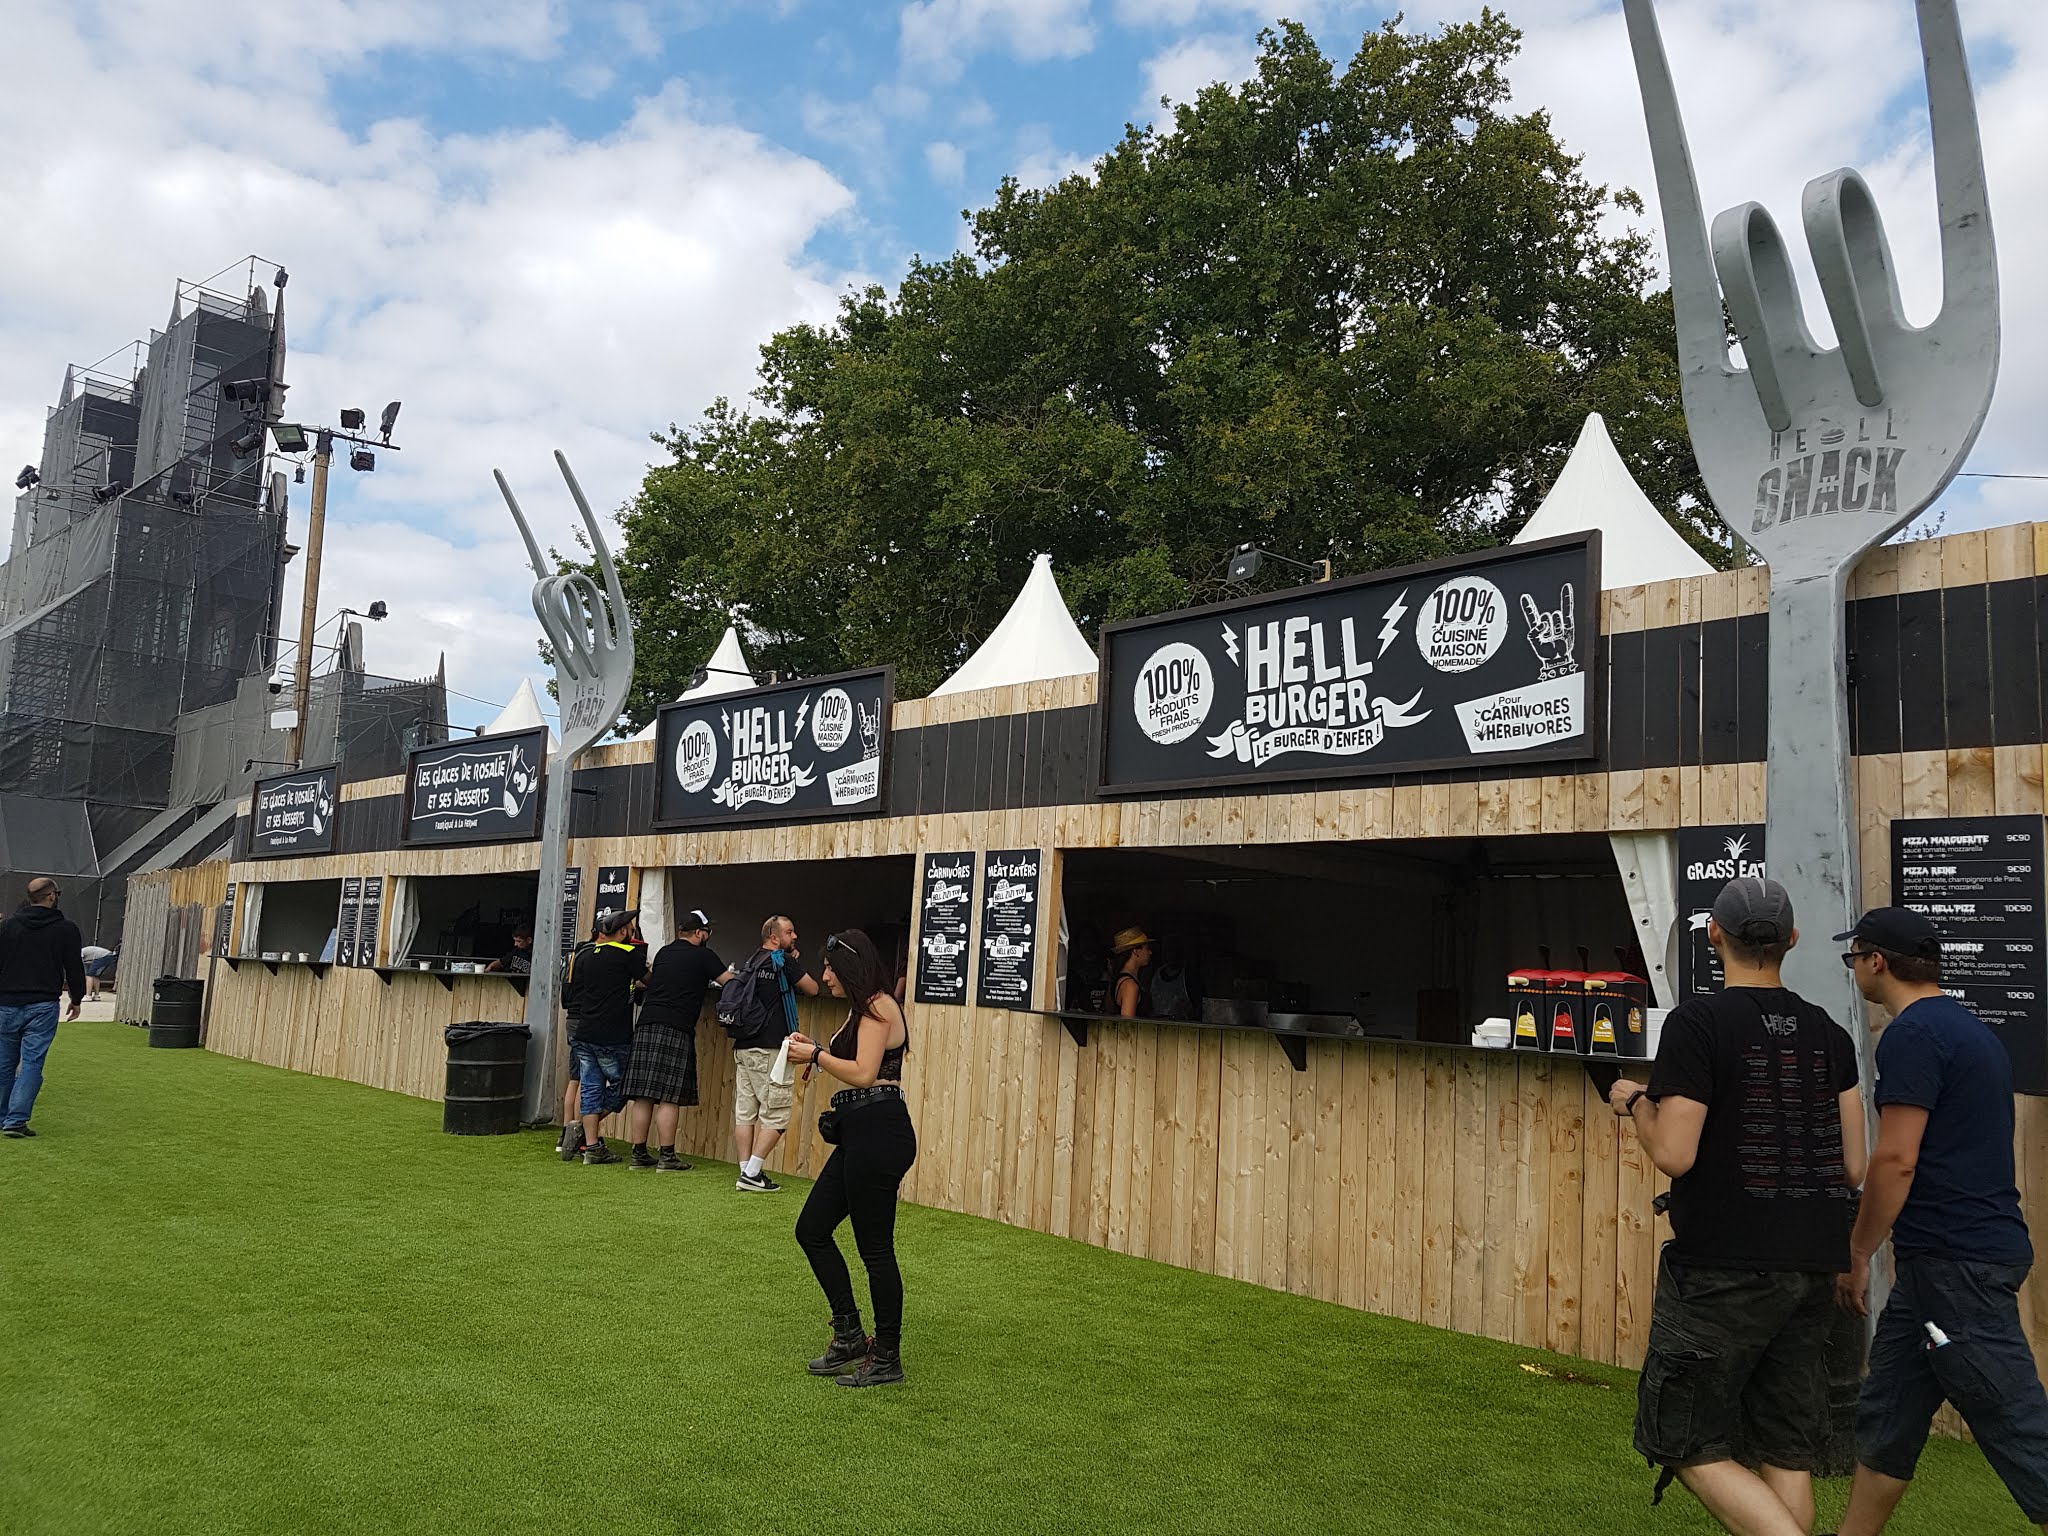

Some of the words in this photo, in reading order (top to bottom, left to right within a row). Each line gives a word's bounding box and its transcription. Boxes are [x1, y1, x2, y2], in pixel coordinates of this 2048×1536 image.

[1751, 446, 1908, 534] SNACK
[1433, 587, 1495, 625] 100%
[1432, 625, 1488, 643] CUISINÉ
[1246, 616, 1374, 692] HELL
[1430, 643, 1487, 657] MAISON
[1432, 658, 1482, 668] HOMEMADE
[1143, 658, 1200, 703] 100%
[820, 695, 847, 721] 100%
[1149, 693, 1199, 719] PRODUITS
[1246, 679, 1370, 729] BURGER
[1498, 696, 1521, 705] Pour
[1160, 709, 1190, 727] FRAIS
[1480, 698, 1570, 722] CARNIVORES
[733, 707, 793, 759] HELL
[817, 732, 843, 742] MAISON
[1151, 726, 1171, 739] FRESH
[1171, 717, 1201, 732] PRODUCE
[1486, 716, 1572, 741] HERBIVORES
[682, 731, 710, 763] 100%
[1256, 740, 1270, 760] LE
[1273, 729, 1320, 749] BURGER
[1323, 729, 1374, 750] D'ENFER
[418, 768, 430, 787] LES
[432, 765, 459, 789] GLACES
[461, 762, 471, 781] DE
[689, 768, 705, 780] FRAIS
[732, 753, 790, 785] BURGER
[837, 771, 875, 785] CARNIVORES
[427, 794, 437, 809] ET
[438, 792, 452, 808] SES
[453, 787, 490, 807] DESSERTS
[736, 793, 743, 804] LE
[744, 785, 767, 798] BURGER
[839, 783, 875, 798] HERBIVORES
[260, 795, 268, 810] LES
[269, 792, 286, 812] GLACES
[265, 815, 272, 828] ET
[281, 810, 305, 827] DESSERTS
[1902, 837, 1929, 847] PIZZA
[1930, 835, 1990, 847] MARGUERITE
[1922, 846, 1947, 854] tomate,
[927, 865, 970, 879] CARNIVORES
[987, 864, 1008, 878] MEAT
[1009, 863, 1037, 877] EATERS
[1686, 859, 1735, 881] GRASS
[1738, 859, 1766, 880] EAT
[1903, 866, 1929, 877] PIZZA
[1931, 866, 1958, 877] REINE
[1903, 884, 1928, 892] jambon
[1928, 883, 1948, 891] blanc,
[1922, 876, 1948, 884] tomate,
[1948, 876, 1992, 885] champignons
[1993, 875, 2003, 883] de
[2003, 875, 2023, 883] Paris,
[1948, 915, 1979, 923] merguez,
[1979, 914, 2006, 922] chorizo,
[1949, 960, 1958, 968] de
[1977, 962, 2007, 970] poivrons
[1974, 969, 2011, 977] mozzarella
[757, 969, 775, 980] iden
[1940, 989, 1966, 999] GAN
